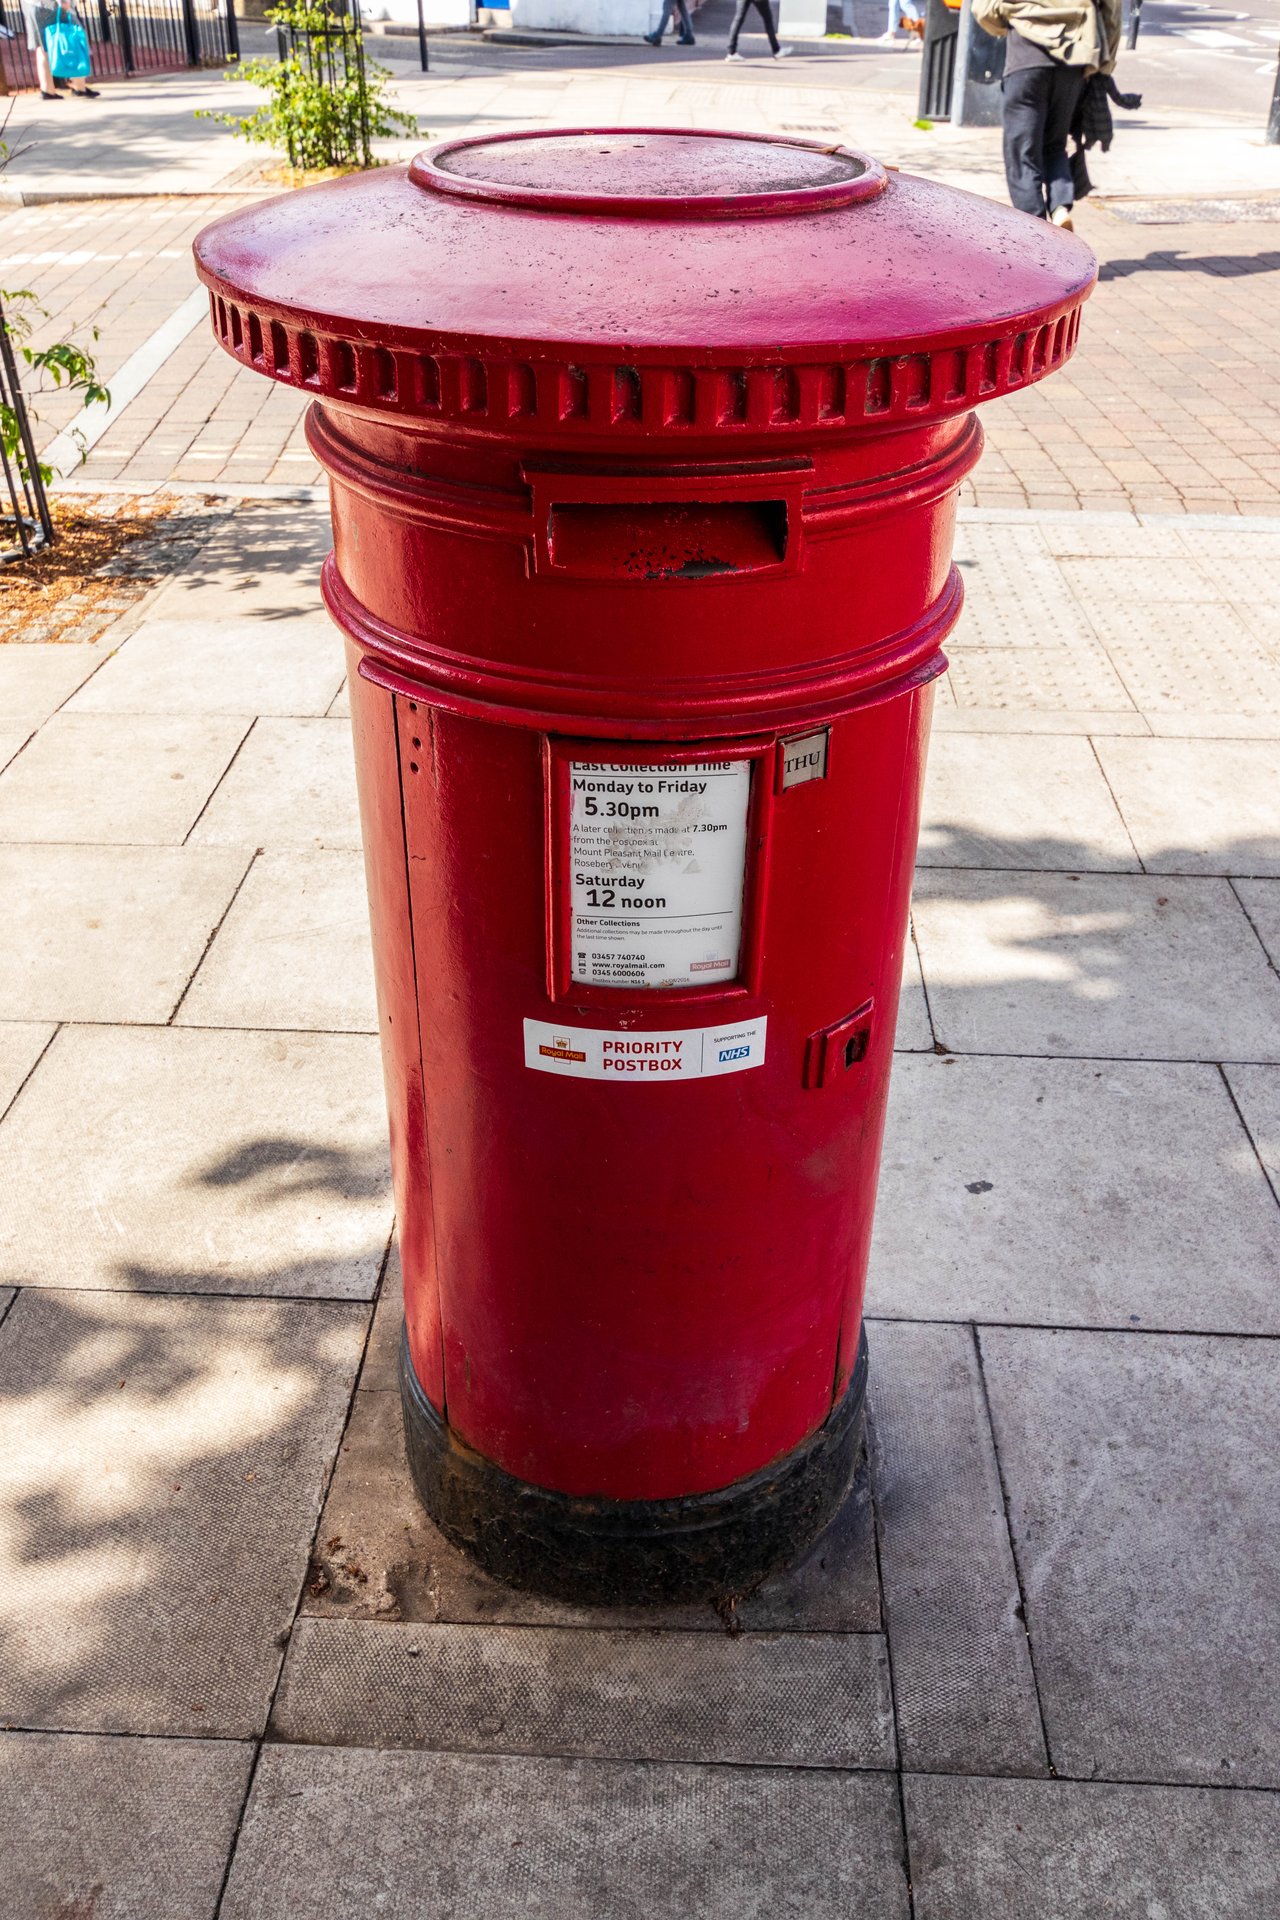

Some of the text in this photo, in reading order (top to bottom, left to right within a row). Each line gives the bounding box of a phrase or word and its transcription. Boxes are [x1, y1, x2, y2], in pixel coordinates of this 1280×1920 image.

[784, 751, 821, 773] THU
[573, 779, 707, 796] Monday to Friday
[585, 797, 659, 820] 5.30pm
[573, 824, 580, 832] A
[581, 825, 601, 833] later
[693, 824, 728, 833] 7.30pm
[573, 836, 594, 844] from
[574, 847, 602, 856] Mount
[604, 848, 641, 858] Pleasant
[575, 873, 645, 890] Saturday
[586, 889, 666, 908] 12 noon
[576, 918, 598, 926] Other
[592, 962, 665, 970] www.royalmail.com
[692, 960, 729, 970] Royal Mail
[714, 1033, 746, 1043] SUPPORTING
[541, 1046, 584, 1060] Royal Mail
[603, 1040, 683, 1054] PRIORITY
[720, 1046, 749, 1061] NHS
[603, 1058, 682, 1072] POSTBOX
